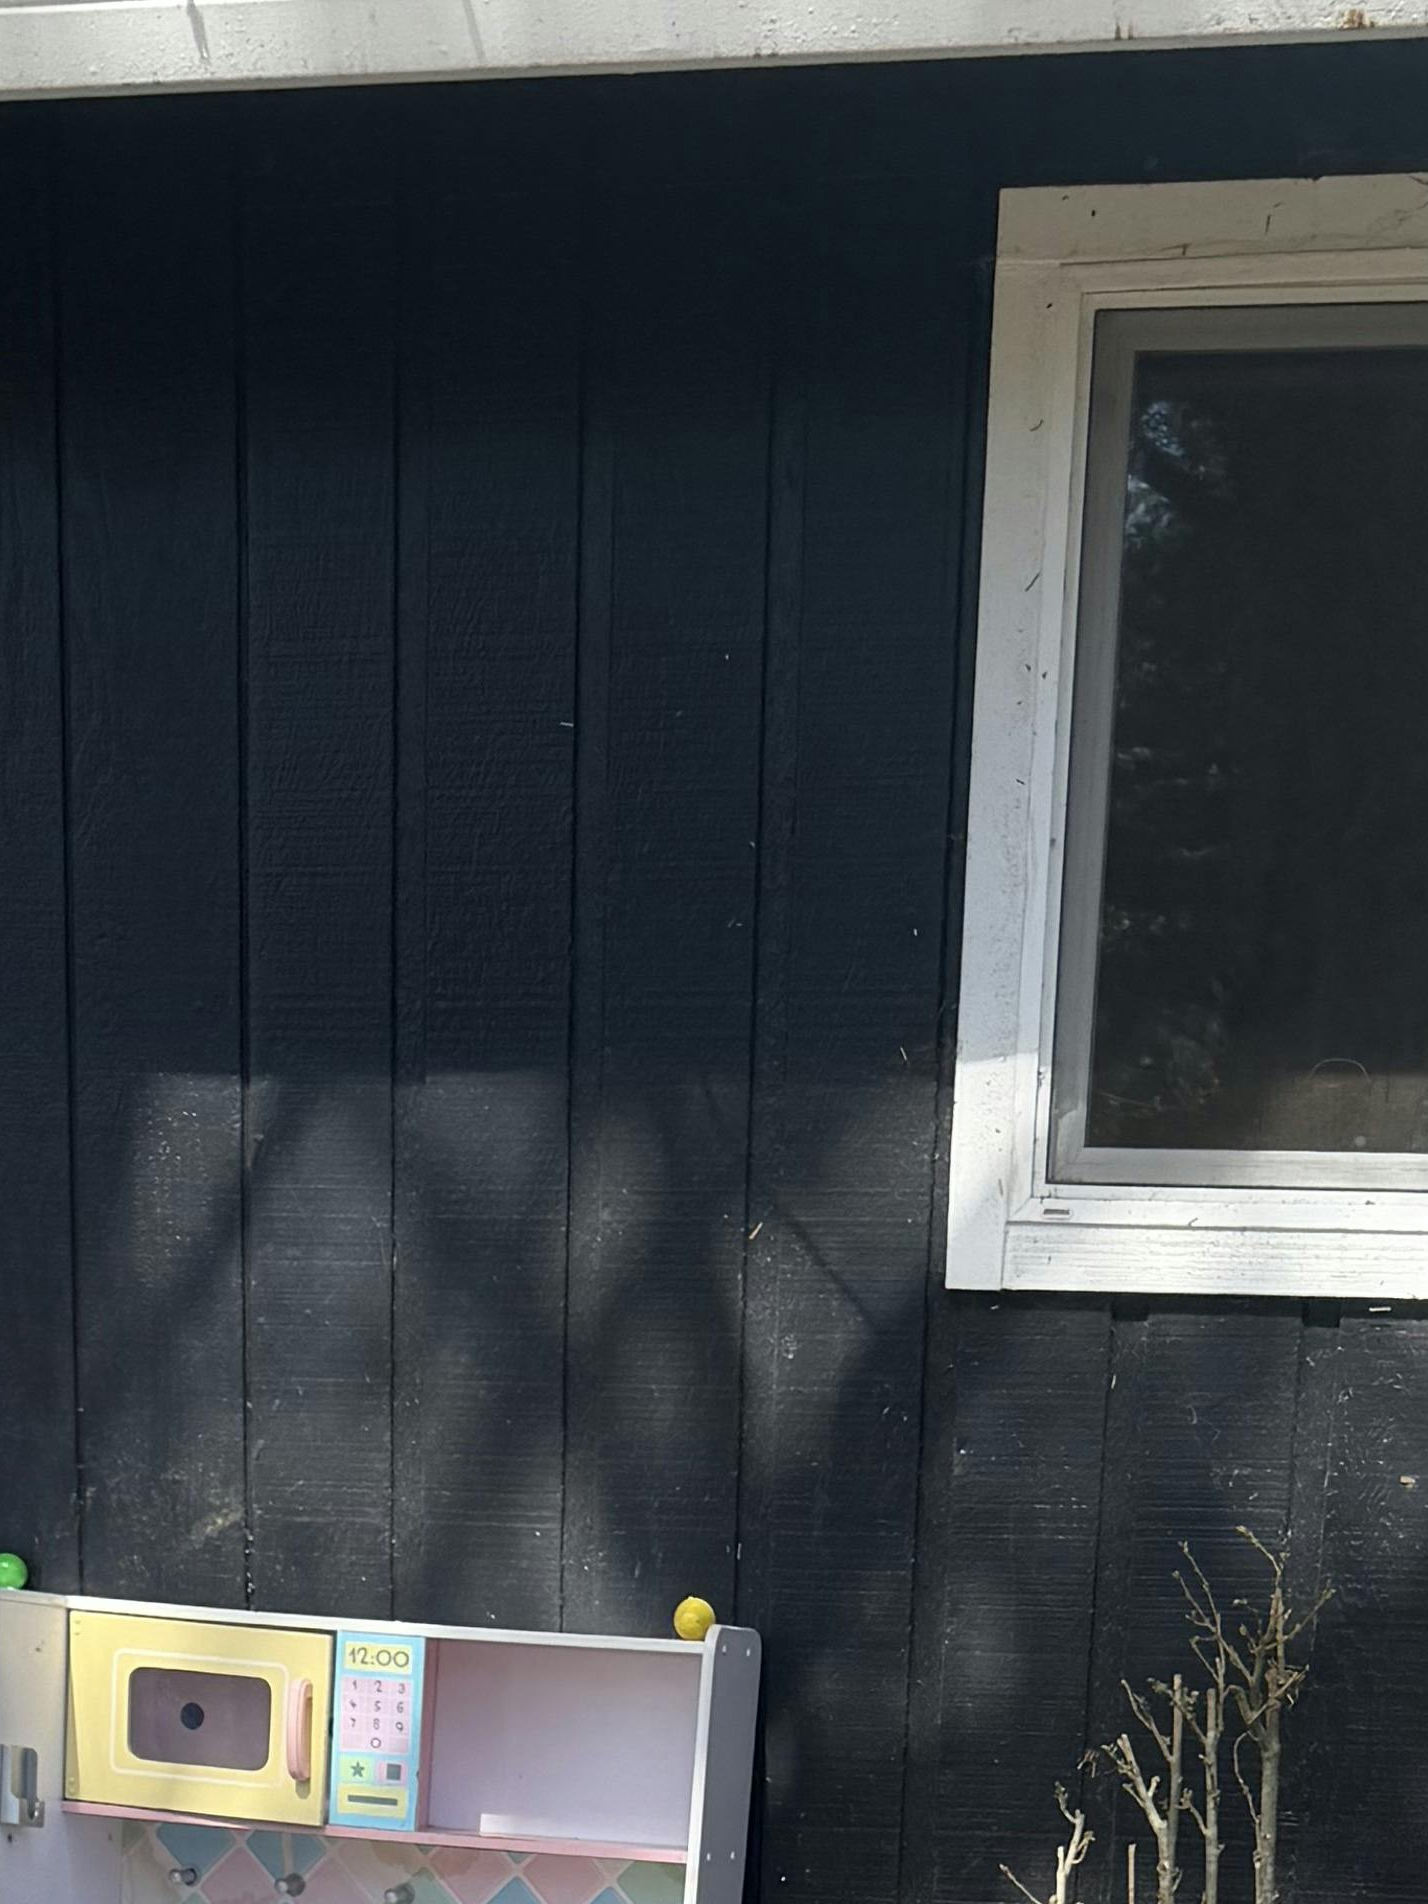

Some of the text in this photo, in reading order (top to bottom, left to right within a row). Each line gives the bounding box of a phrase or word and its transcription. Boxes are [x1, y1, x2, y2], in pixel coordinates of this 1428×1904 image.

[349, 1647, 409, 1668] 12:00
[352, 1680, 406, 1694] 1 2 3
[374, 1700, 381, 1712] 5
[396, 1701, 404, 1713] 6
[349, 1717, 404, 1733] 7 8 9
